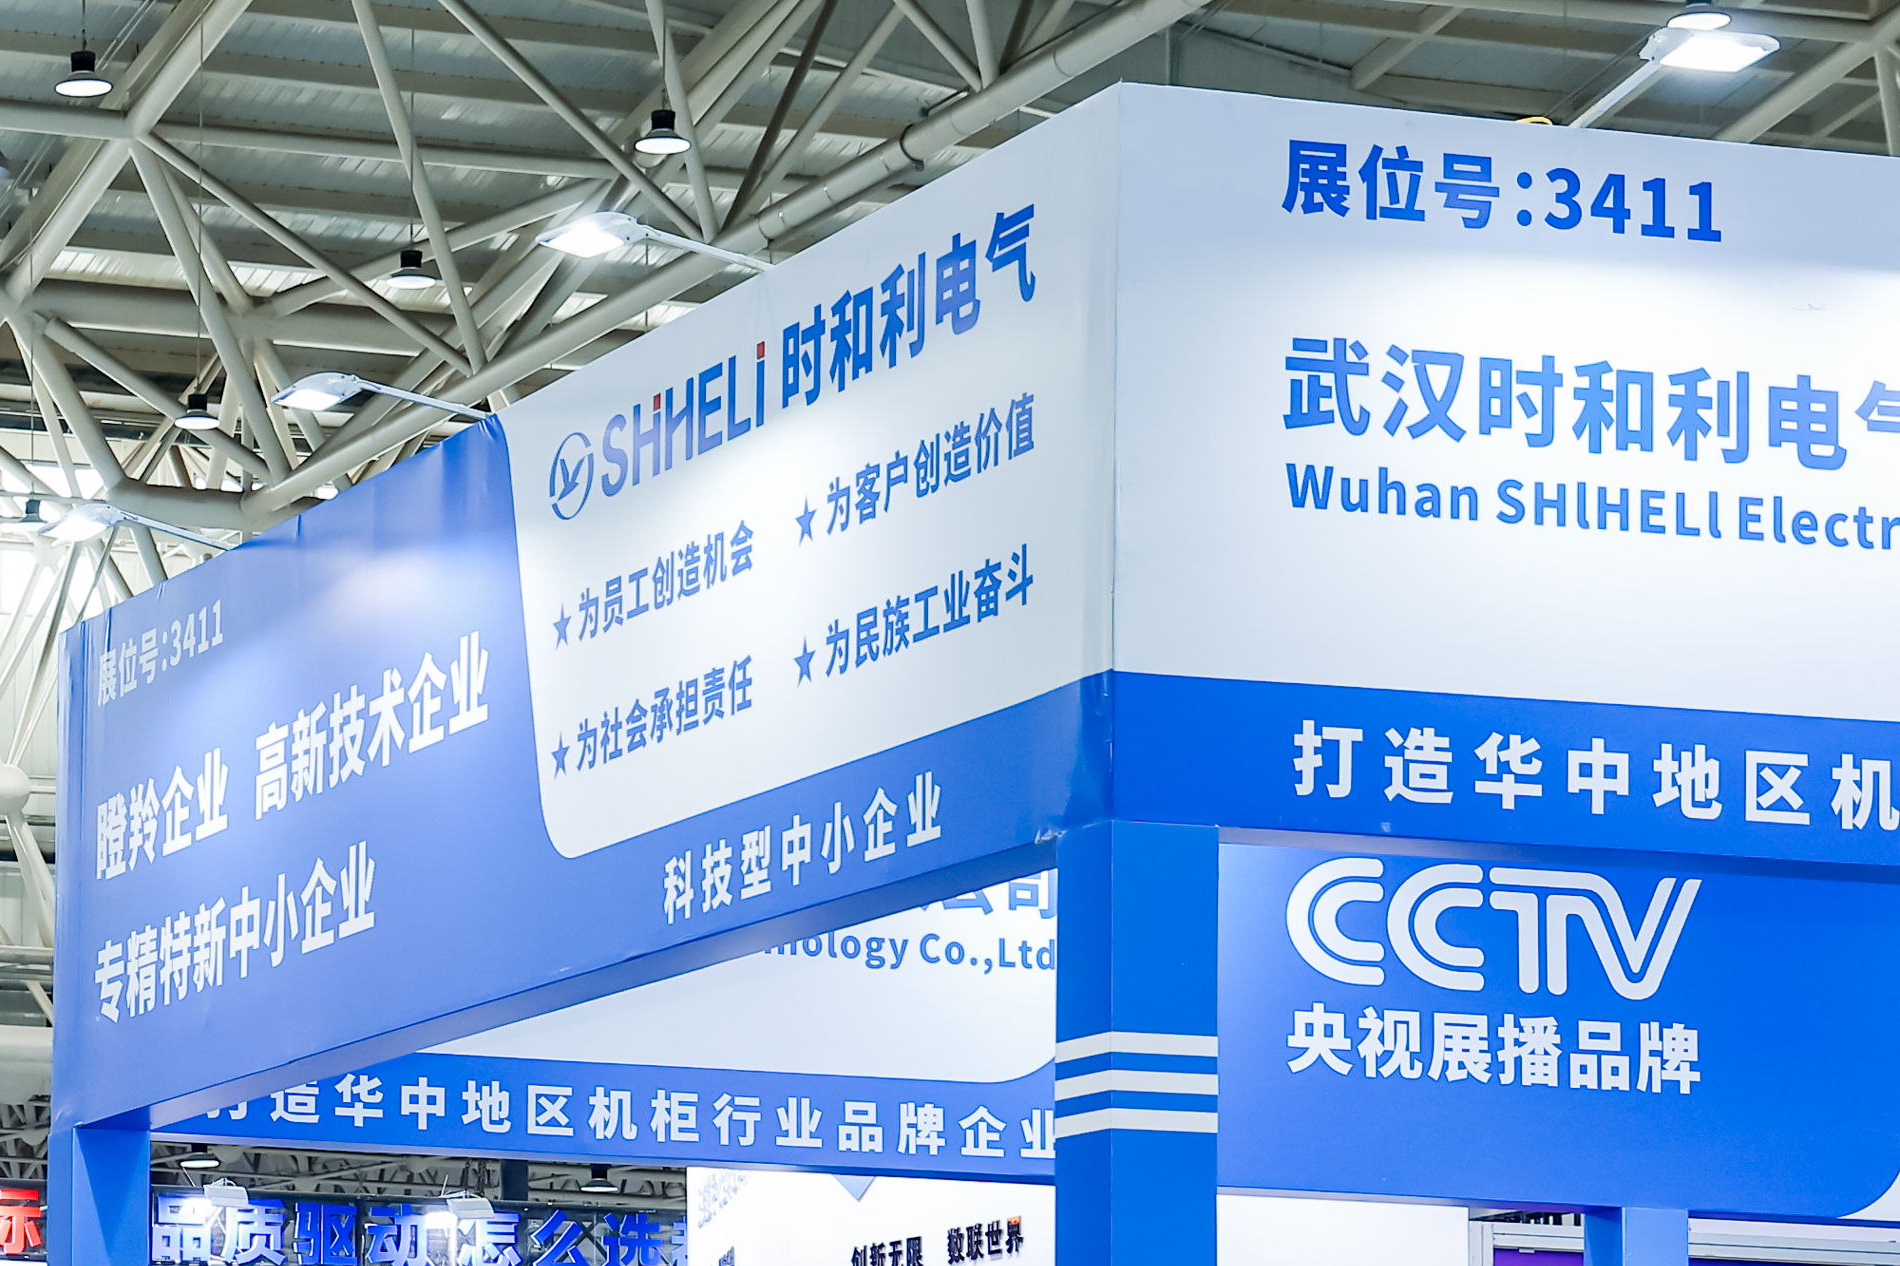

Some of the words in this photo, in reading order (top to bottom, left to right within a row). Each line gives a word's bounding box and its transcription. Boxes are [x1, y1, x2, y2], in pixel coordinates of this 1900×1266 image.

[1281, 139, 1722, 242] 展位号:3411
[782, 203, 1036, 409] 时和利电气
[827, 392, 1036, 535] 为客户创造价值
[1285, 462, 1479, 522] Wuhan
[578, 520, 754, 642] 为员工创造机会
[826, 544, 1034, 678] 为民族工业奋斗
[97, 599, 223, 706] 展位号:3411
[577, 655, 753, 772] 为社会承担责任
[96, 747, 229, 880] 瞪羚企业
[255, 630, 490, 821] 高新技术企业
[1293, 719, 1900, 832] 打造华中地区机
[664, 771, 943, 925] 科技型中小企业
[94, 840, 376, 1024] 专精特新中小企业
[1286, 856, 1702, 1001] CCTV
[1286, 1002, 1700, 1094] 央视展播品牌
[947, 1215, 1024, 1265] 数联世界
